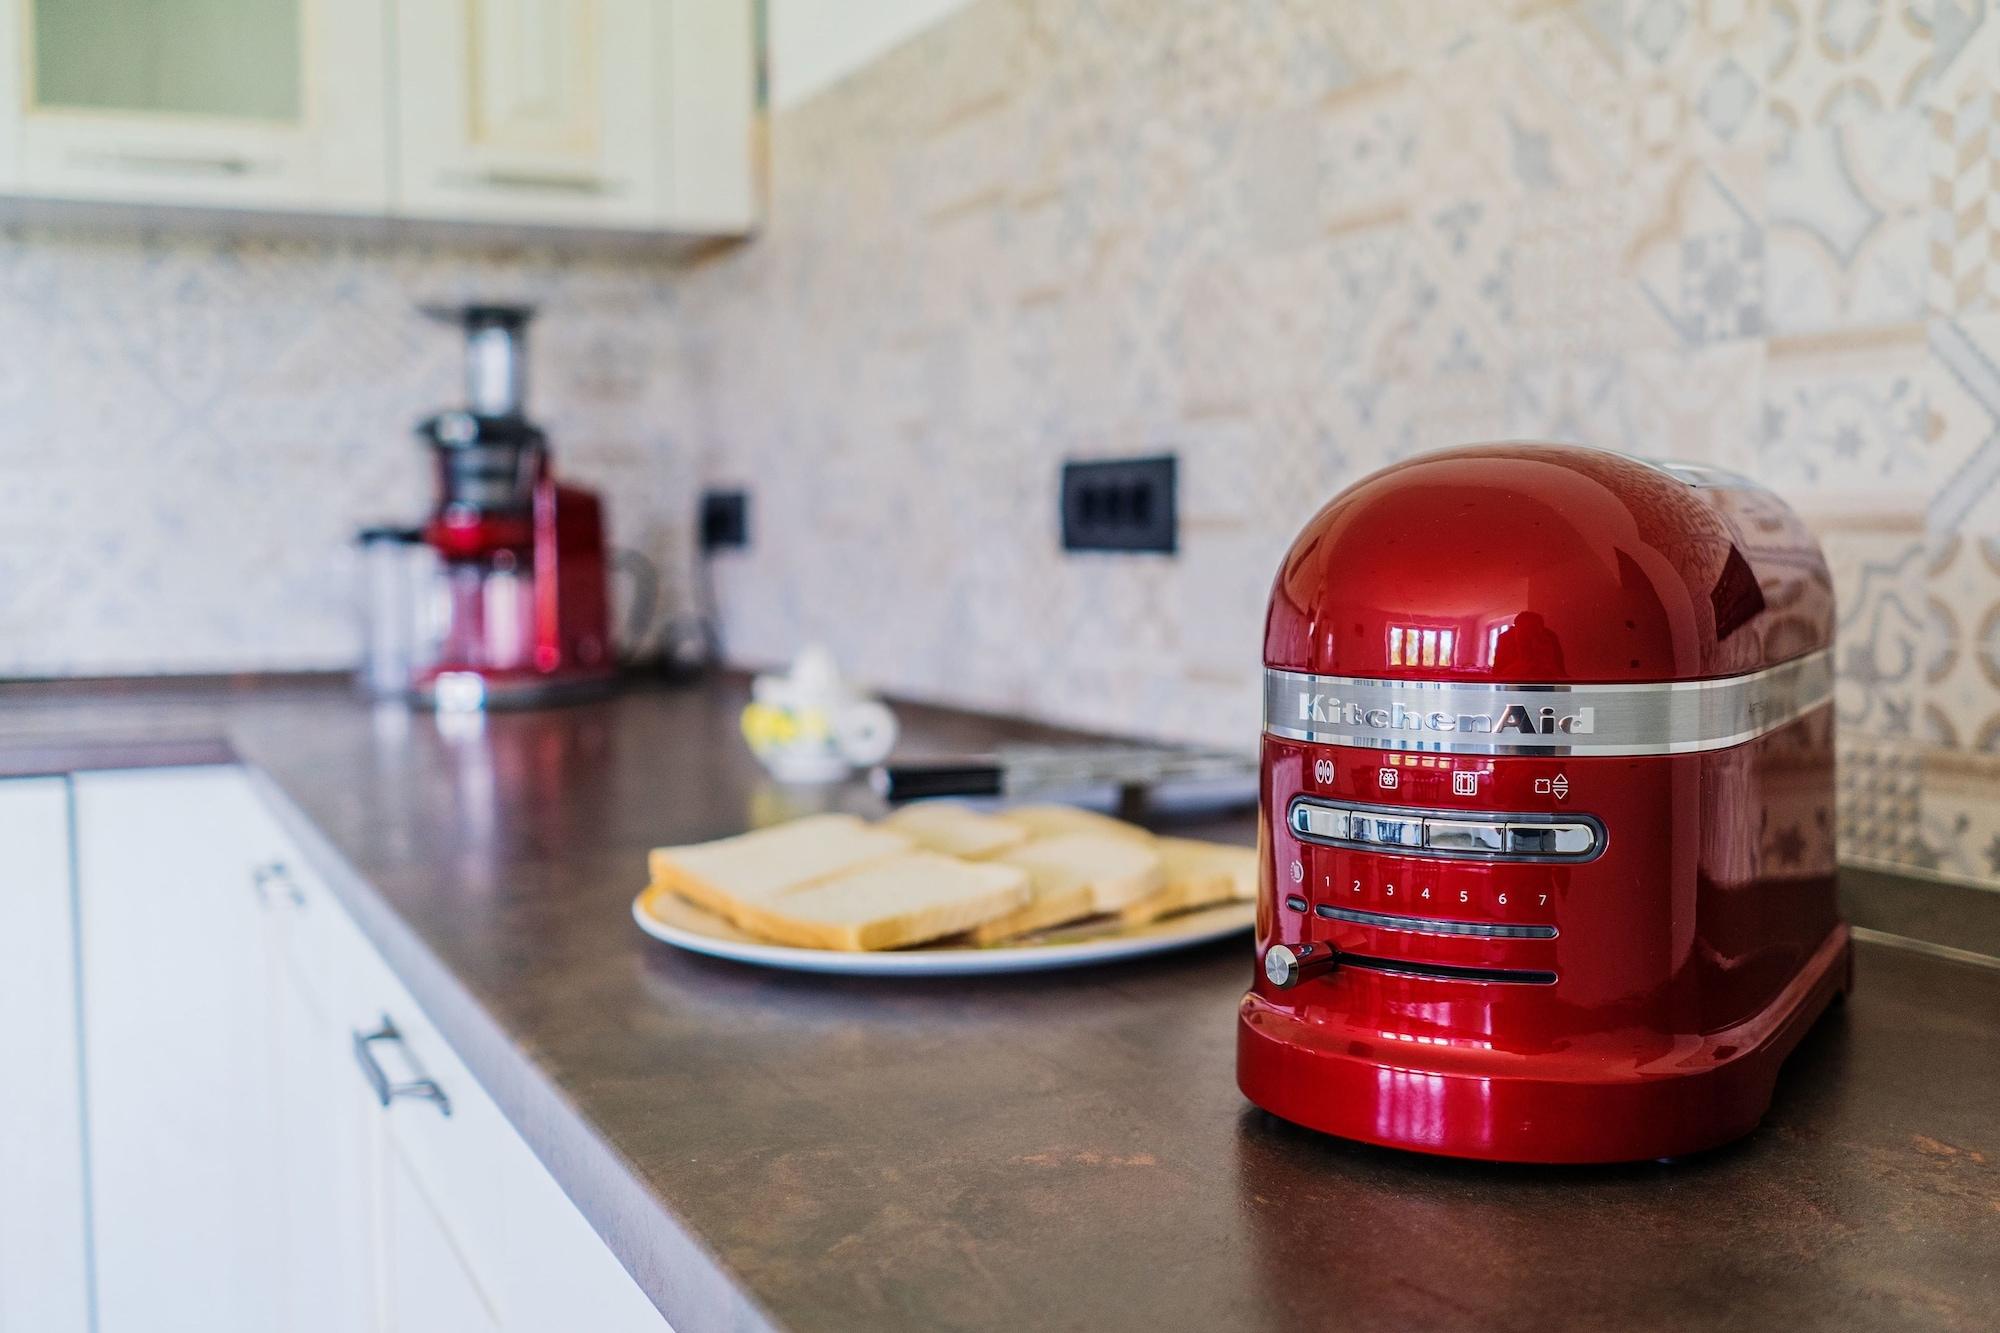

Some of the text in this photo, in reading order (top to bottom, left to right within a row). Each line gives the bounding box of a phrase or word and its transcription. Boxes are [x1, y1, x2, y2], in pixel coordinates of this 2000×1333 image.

[1299, 692, 1595, 734] KitchenAid
[1325, 875, 1547, 906] 1 2 3 4 5 6 7
